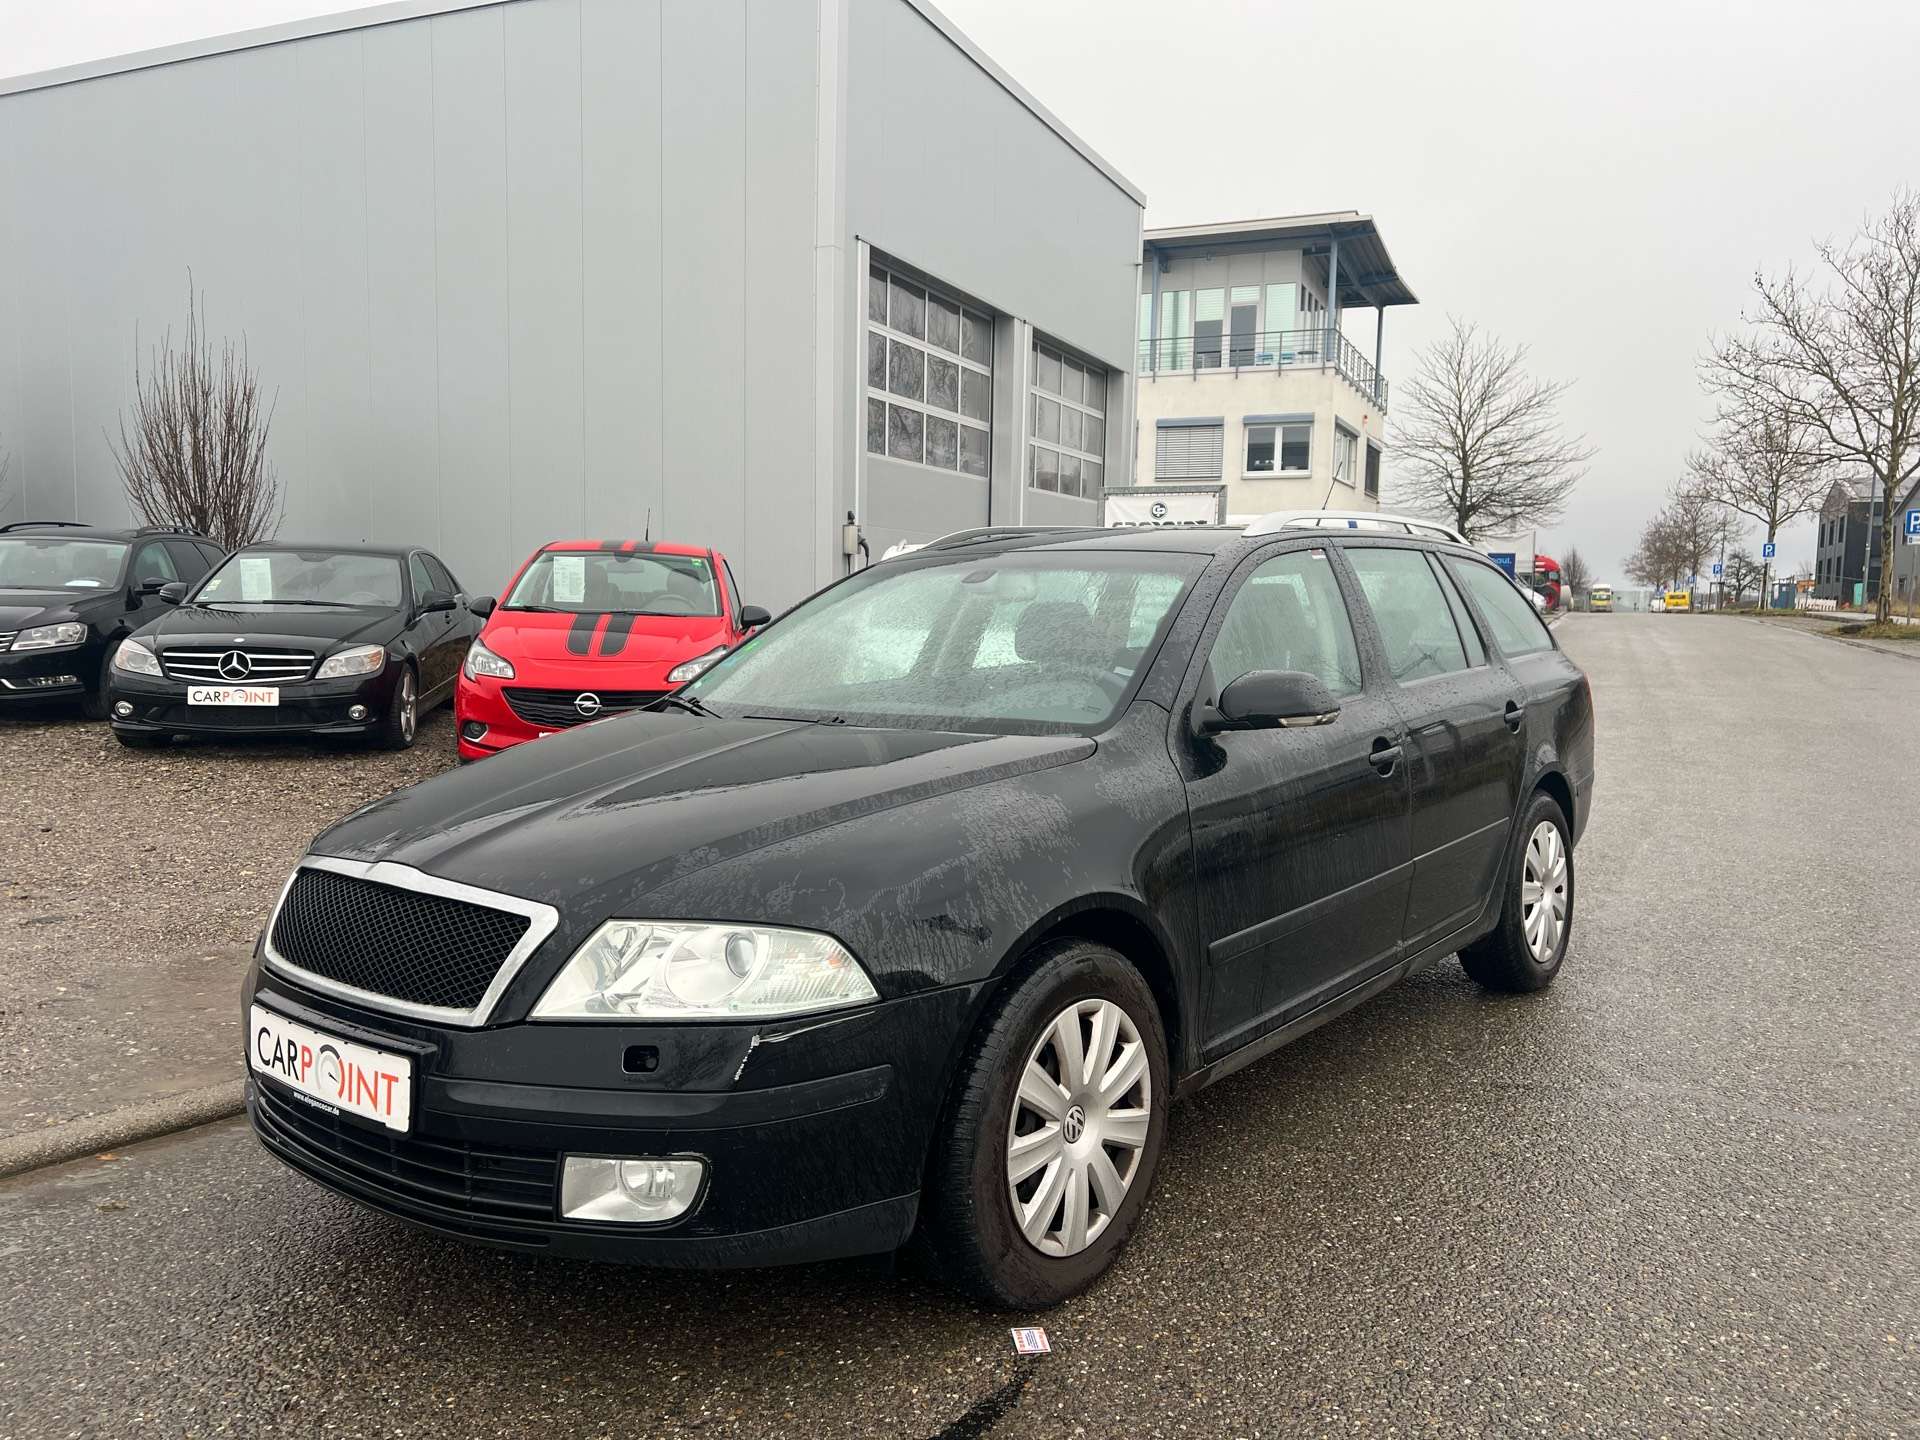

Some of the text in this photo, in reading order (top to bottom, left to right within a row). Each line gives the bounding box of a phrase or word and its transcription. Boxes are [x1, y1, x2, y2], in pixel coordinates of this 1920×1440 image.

[1765, 545, 1773, 556] P
[192, 688, 274, 704] CARPOINT
[257, 1026, 400, 1116] CARPOINT
